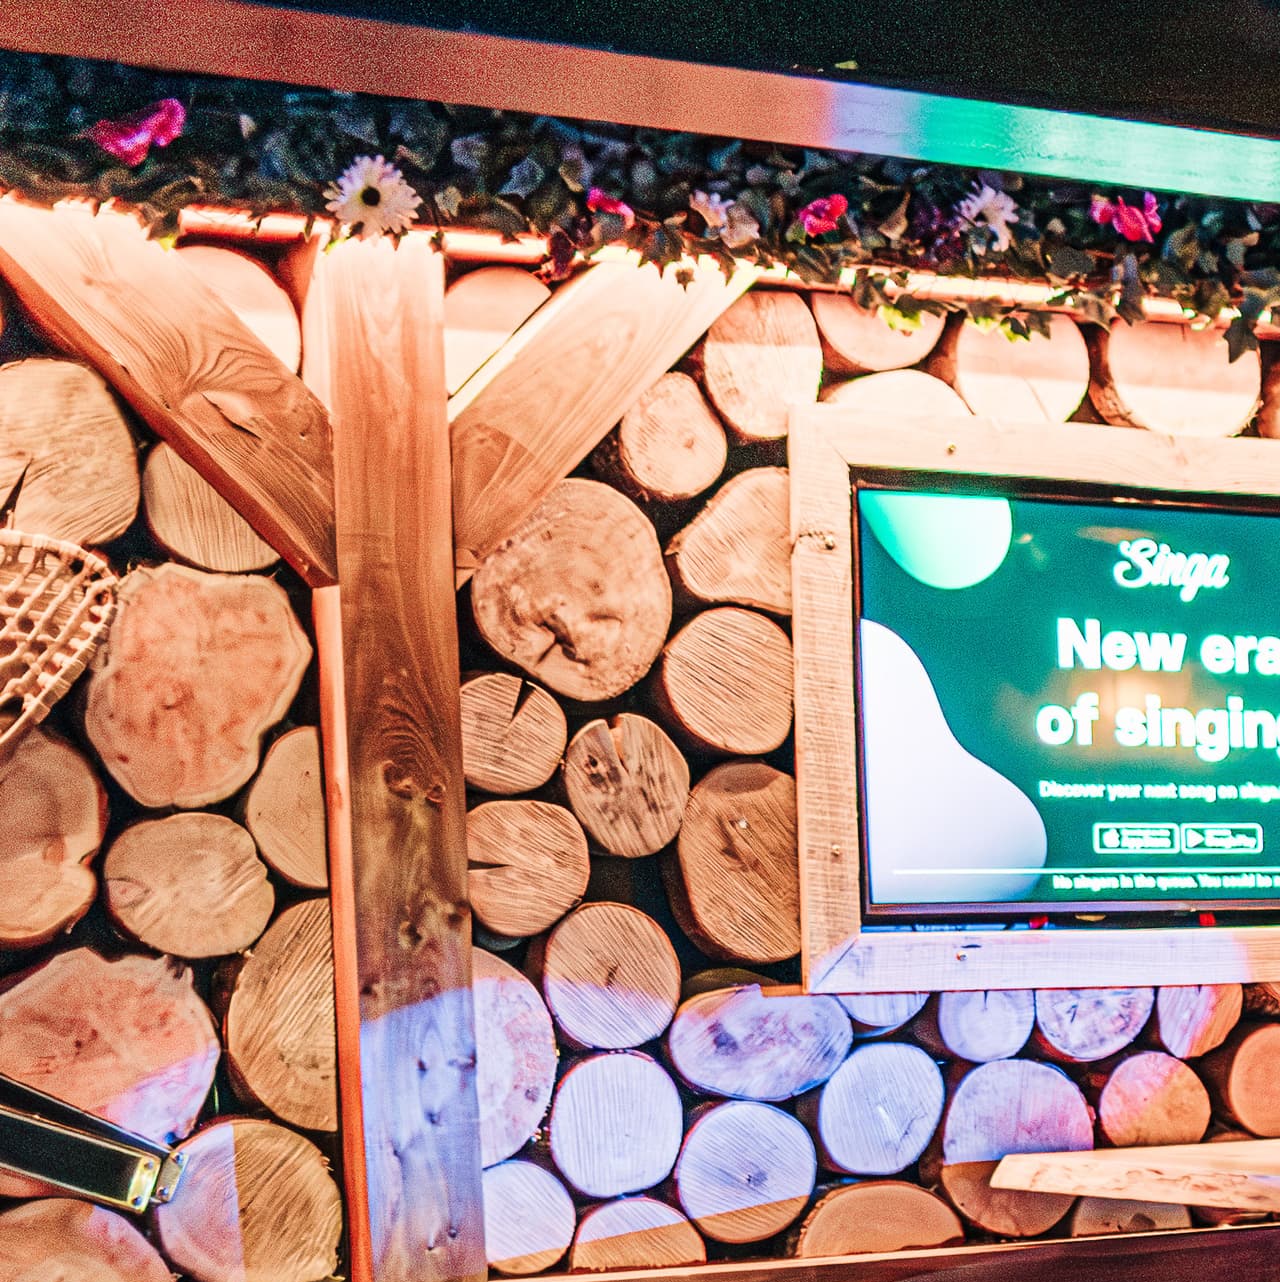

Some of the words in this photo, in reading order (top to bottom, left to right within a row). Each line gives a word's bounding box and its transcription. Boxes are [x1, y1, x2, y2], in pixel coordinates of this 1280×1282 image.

[1113, 538, 1229, 602] Singa
[1057, 617, 1187, 672] New
[1036, 692, 1099, 745] of
[1039, 780, 1105, 798] Discover
[1107, 784, 1142, 801] your
[1144, 783, 1177, 798] next
[1178, 785, 1216, 802] song
[1217, 785, 1238, 799] on
[1053, 875, 1073, 889] No
[1120, 875, 1133, 888] in
[1134, 874, 1156, 888] the
[1198, 874, 1221, 887] You
[1256, 874, 1272, 887] be
